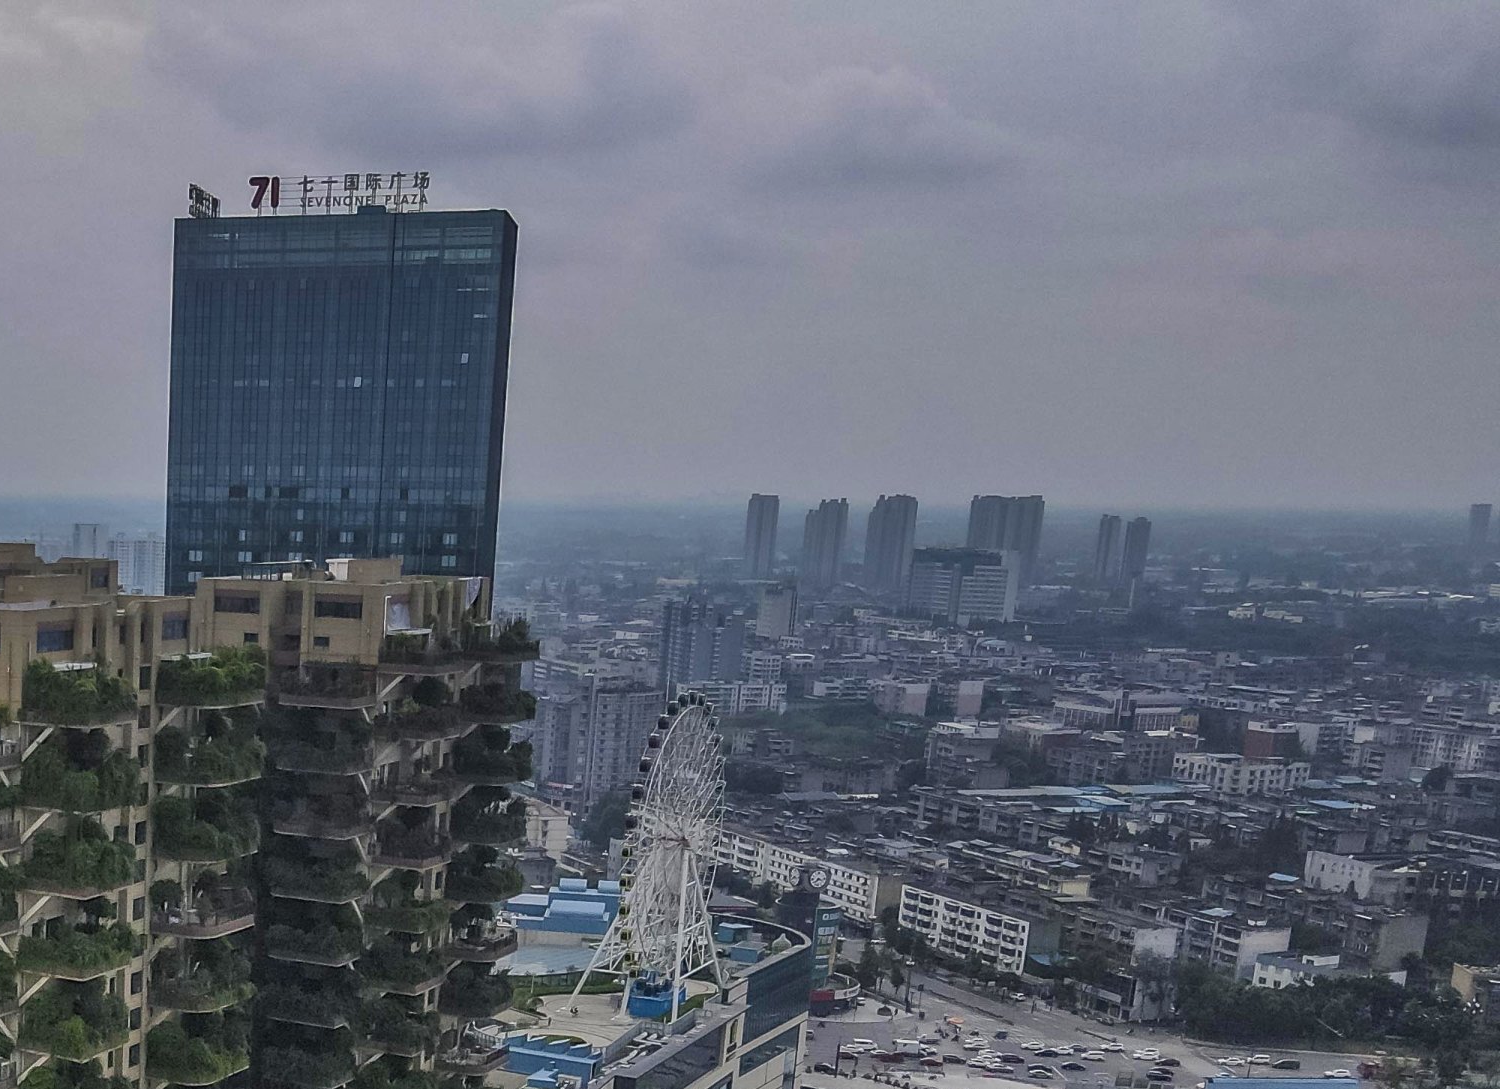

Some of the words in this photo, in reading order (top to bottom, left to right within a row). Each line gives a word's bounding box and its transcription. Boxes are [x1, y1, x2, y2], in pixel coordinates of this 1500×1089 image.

[248, 176, 280, 209] 71
[300, 195, 372, 207] SEVENONE
[385, 193, 429, 205] PLAZA
